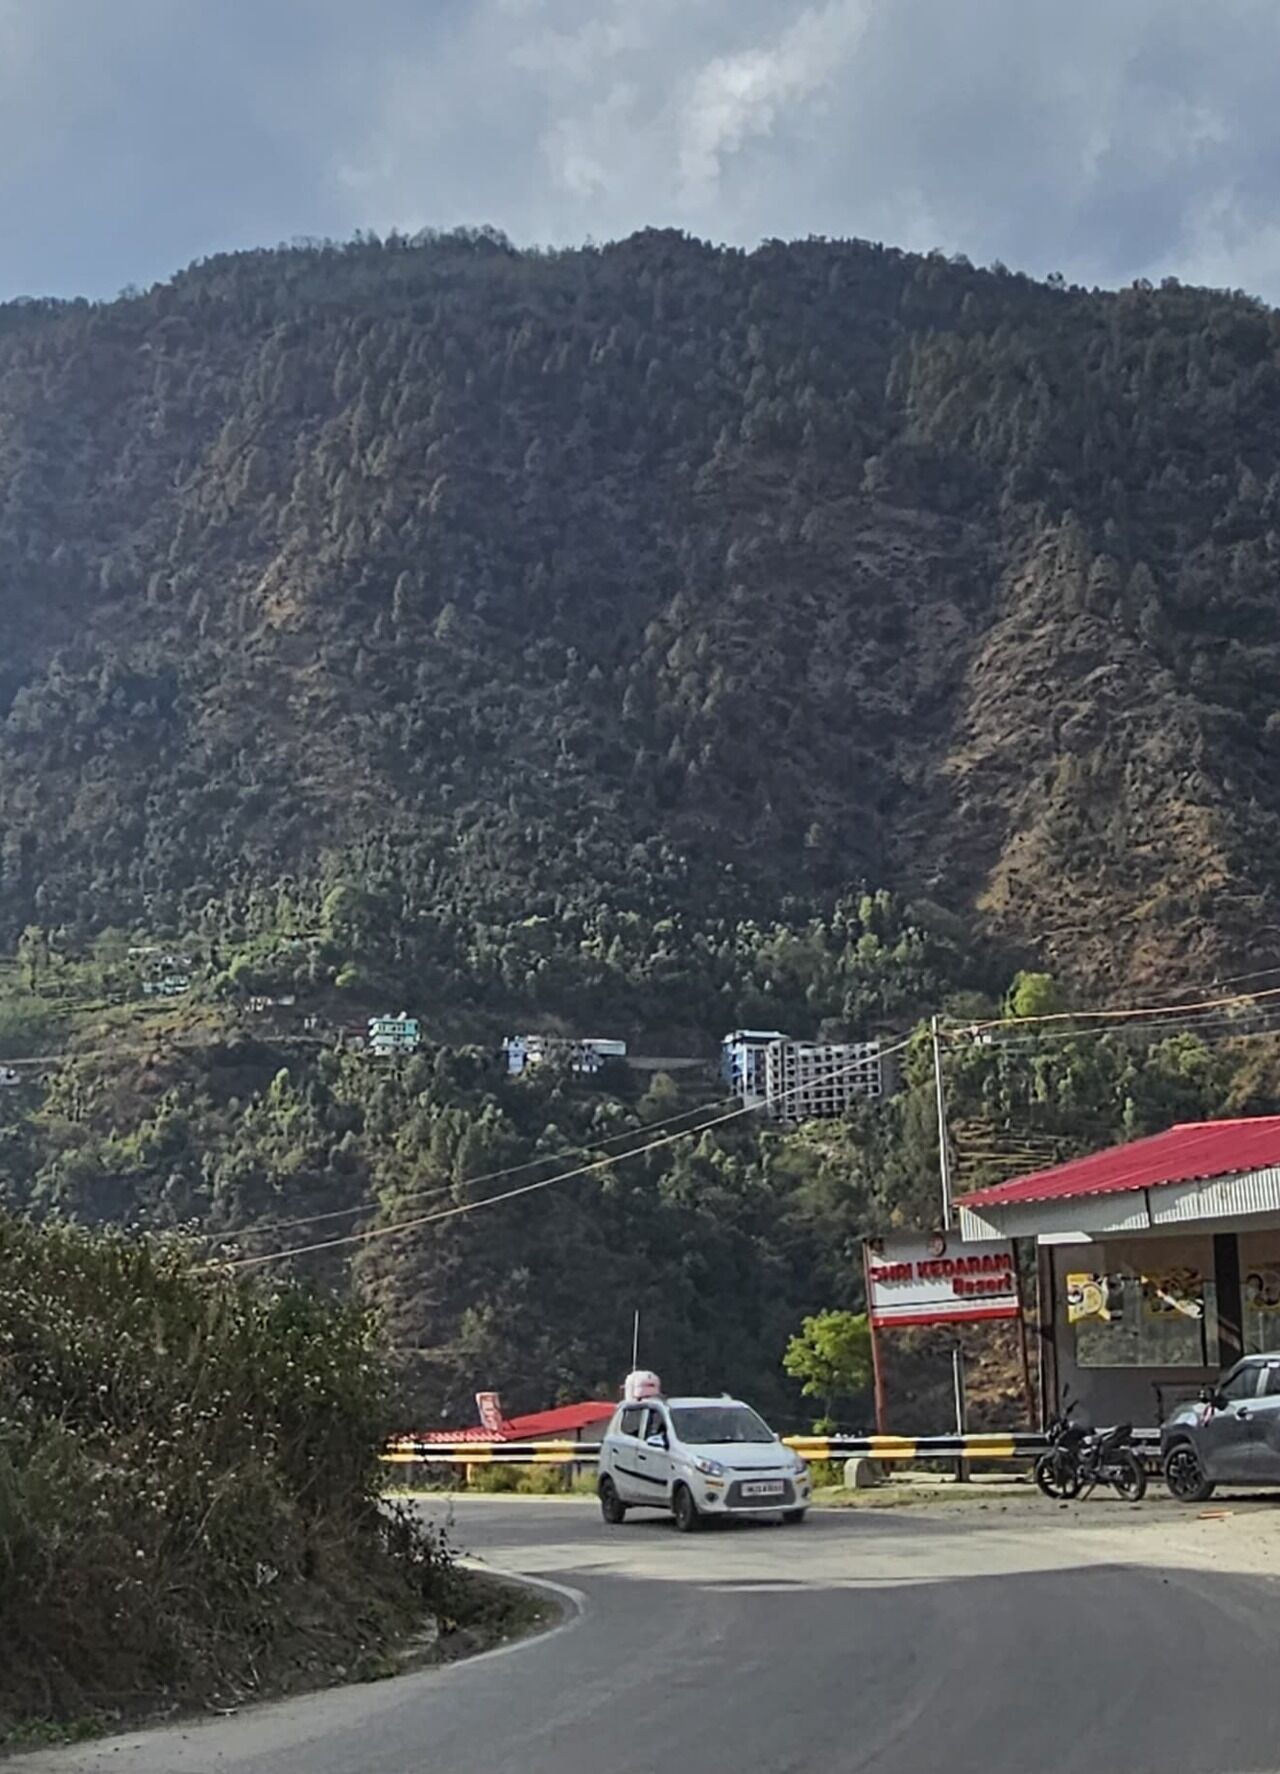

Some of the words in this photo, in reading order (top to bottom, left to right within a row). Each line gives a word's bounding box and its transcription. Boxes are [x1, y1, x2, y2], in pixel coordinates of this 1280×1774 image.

[871, 1263, 913, 1283] SHRI
[917, 1253, 1012, 1279] KEDARAM
[952, 1273, 1012, 1296] Resort
